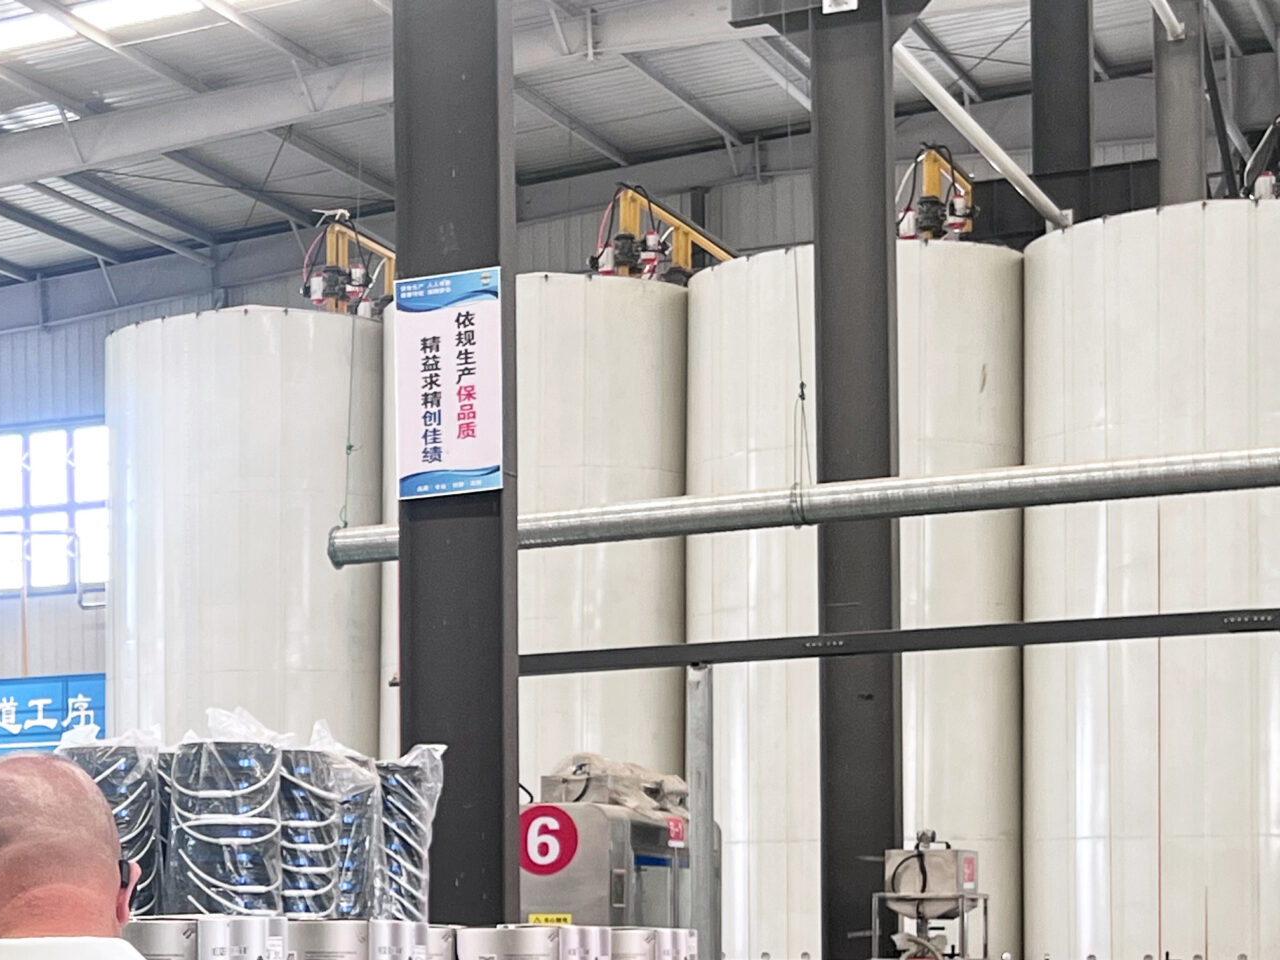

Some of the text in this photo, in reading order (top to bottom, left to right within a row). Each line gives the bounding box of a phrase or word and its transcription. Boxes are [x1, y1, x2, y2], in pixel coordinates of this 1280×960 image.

[420, 336, 442, 464] 精益求精创佳绩
[455, 311, 476, 440] 依规生产保品质
[527, 816, 560, 865] 6
